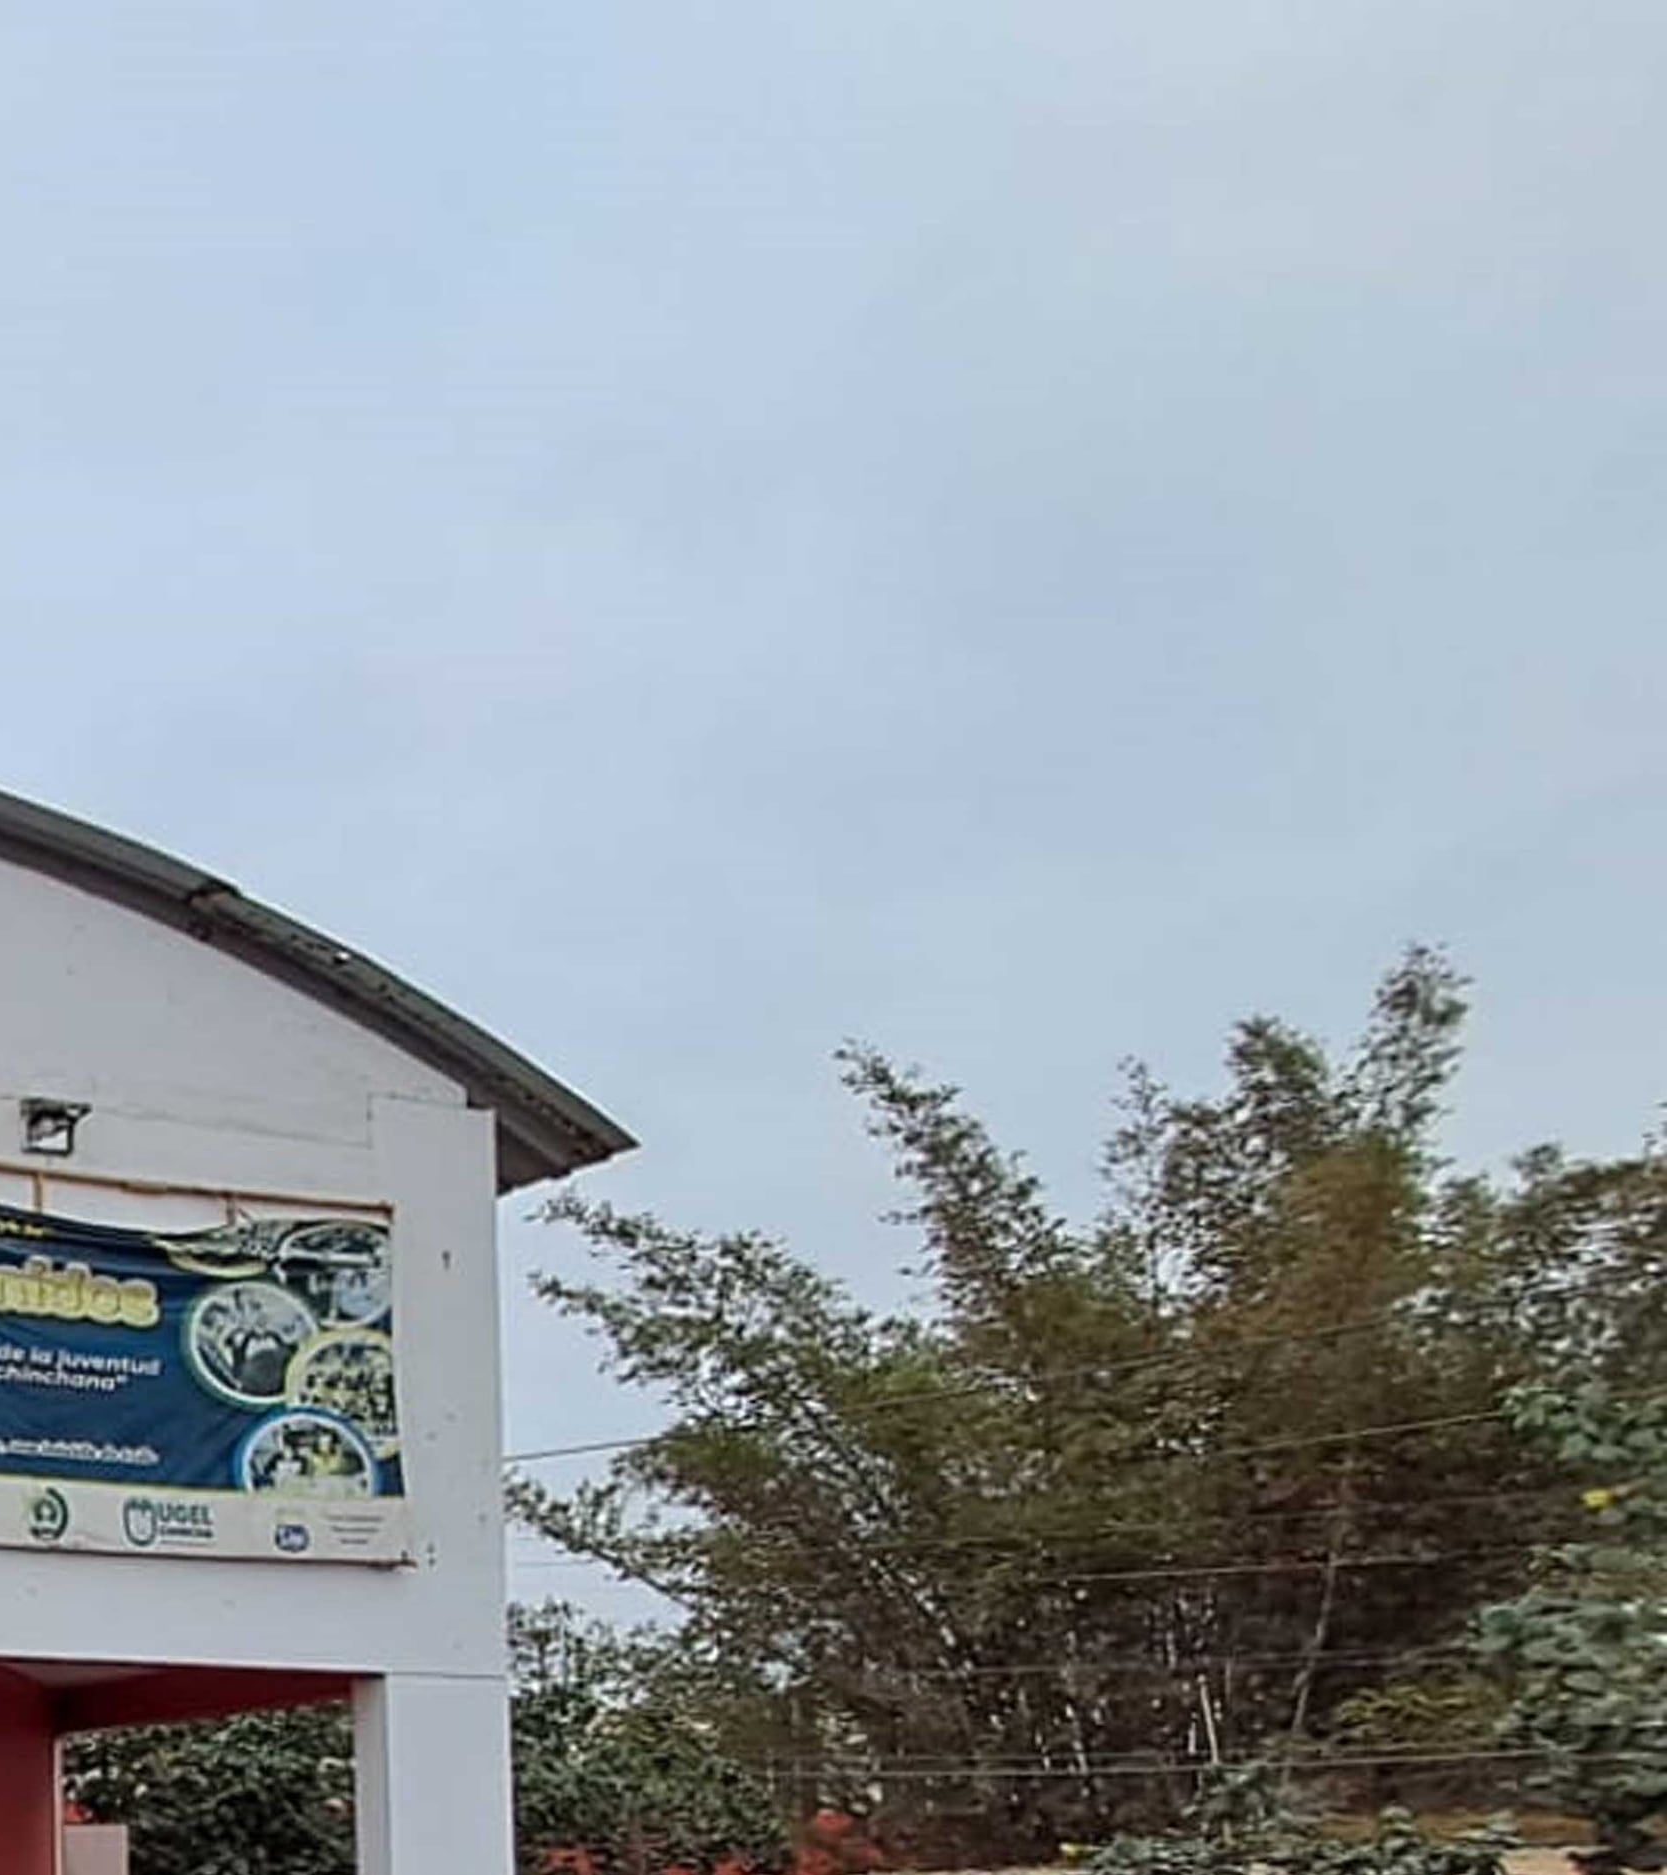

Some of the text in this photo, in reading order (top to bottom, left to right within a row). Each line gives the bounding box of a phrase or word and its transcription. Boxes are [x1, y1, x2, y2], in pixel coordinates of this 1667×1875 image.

[30, 1347, 53, 1365] la
[55, 1348, 161, 1376] juventud
[157, 1502, 214, 1526] UGEL
